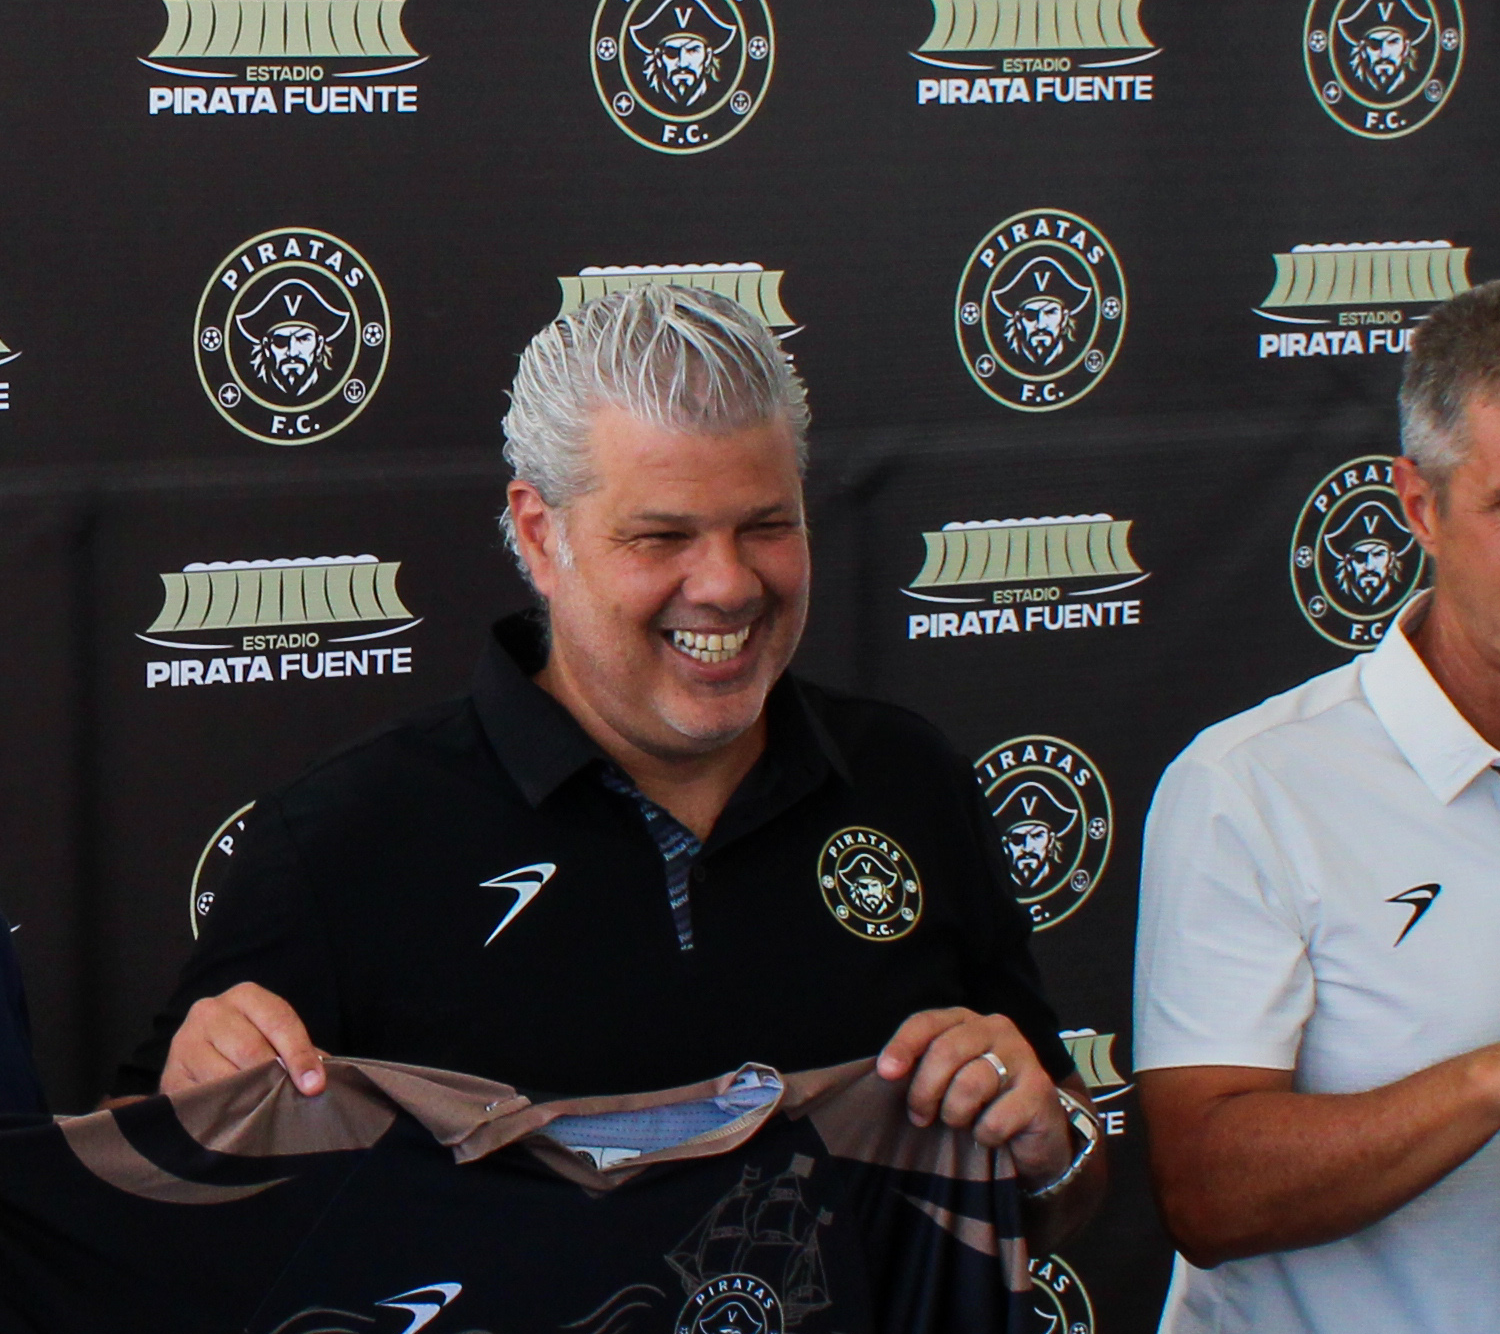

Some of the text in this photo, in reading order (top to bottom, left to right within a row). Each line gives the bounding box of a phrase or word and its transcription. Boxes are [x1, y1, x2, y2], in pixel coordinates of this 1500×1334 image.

[246, 65, 324, 82] ESTADIO
[1003, 57, 1071, 73] ESTADIO
[149, 85, 418, 115] PIRATA FUENTE
[918, 75, 1153, 105] PIRATA FUENTE
[662, 124, 709, 144] F.C.
[1365, 110, 1407, 130] F.C.
[980, 218, 1105, 268] PIRATAS
[221, 237, 364, 291] PIRATAS
[1339, 310, 1402, 326] ESTADIO
[1260, 330, 1364, 359] PIRATA
[1021, 382, 1065, 403] F.C.
[271, 414, 320, 435] F.C.
[1314, 464, 1394, 513] PIRAT
[993, 586, 1060, 605] ESTADIO
[909, 599, 1141, 640] PIRATA FUENTE
[242, 632, 320, 651] ESTADIO
[146, 646, 412, 689] PIRATA FUENTE
[977, 744, 1092, 787] IRATAS
[825, 831, 901, 868] PIRATAS
[866, 923, 894, 935] F.C.
[695, 1278, 775, 1310] PIRATAS
